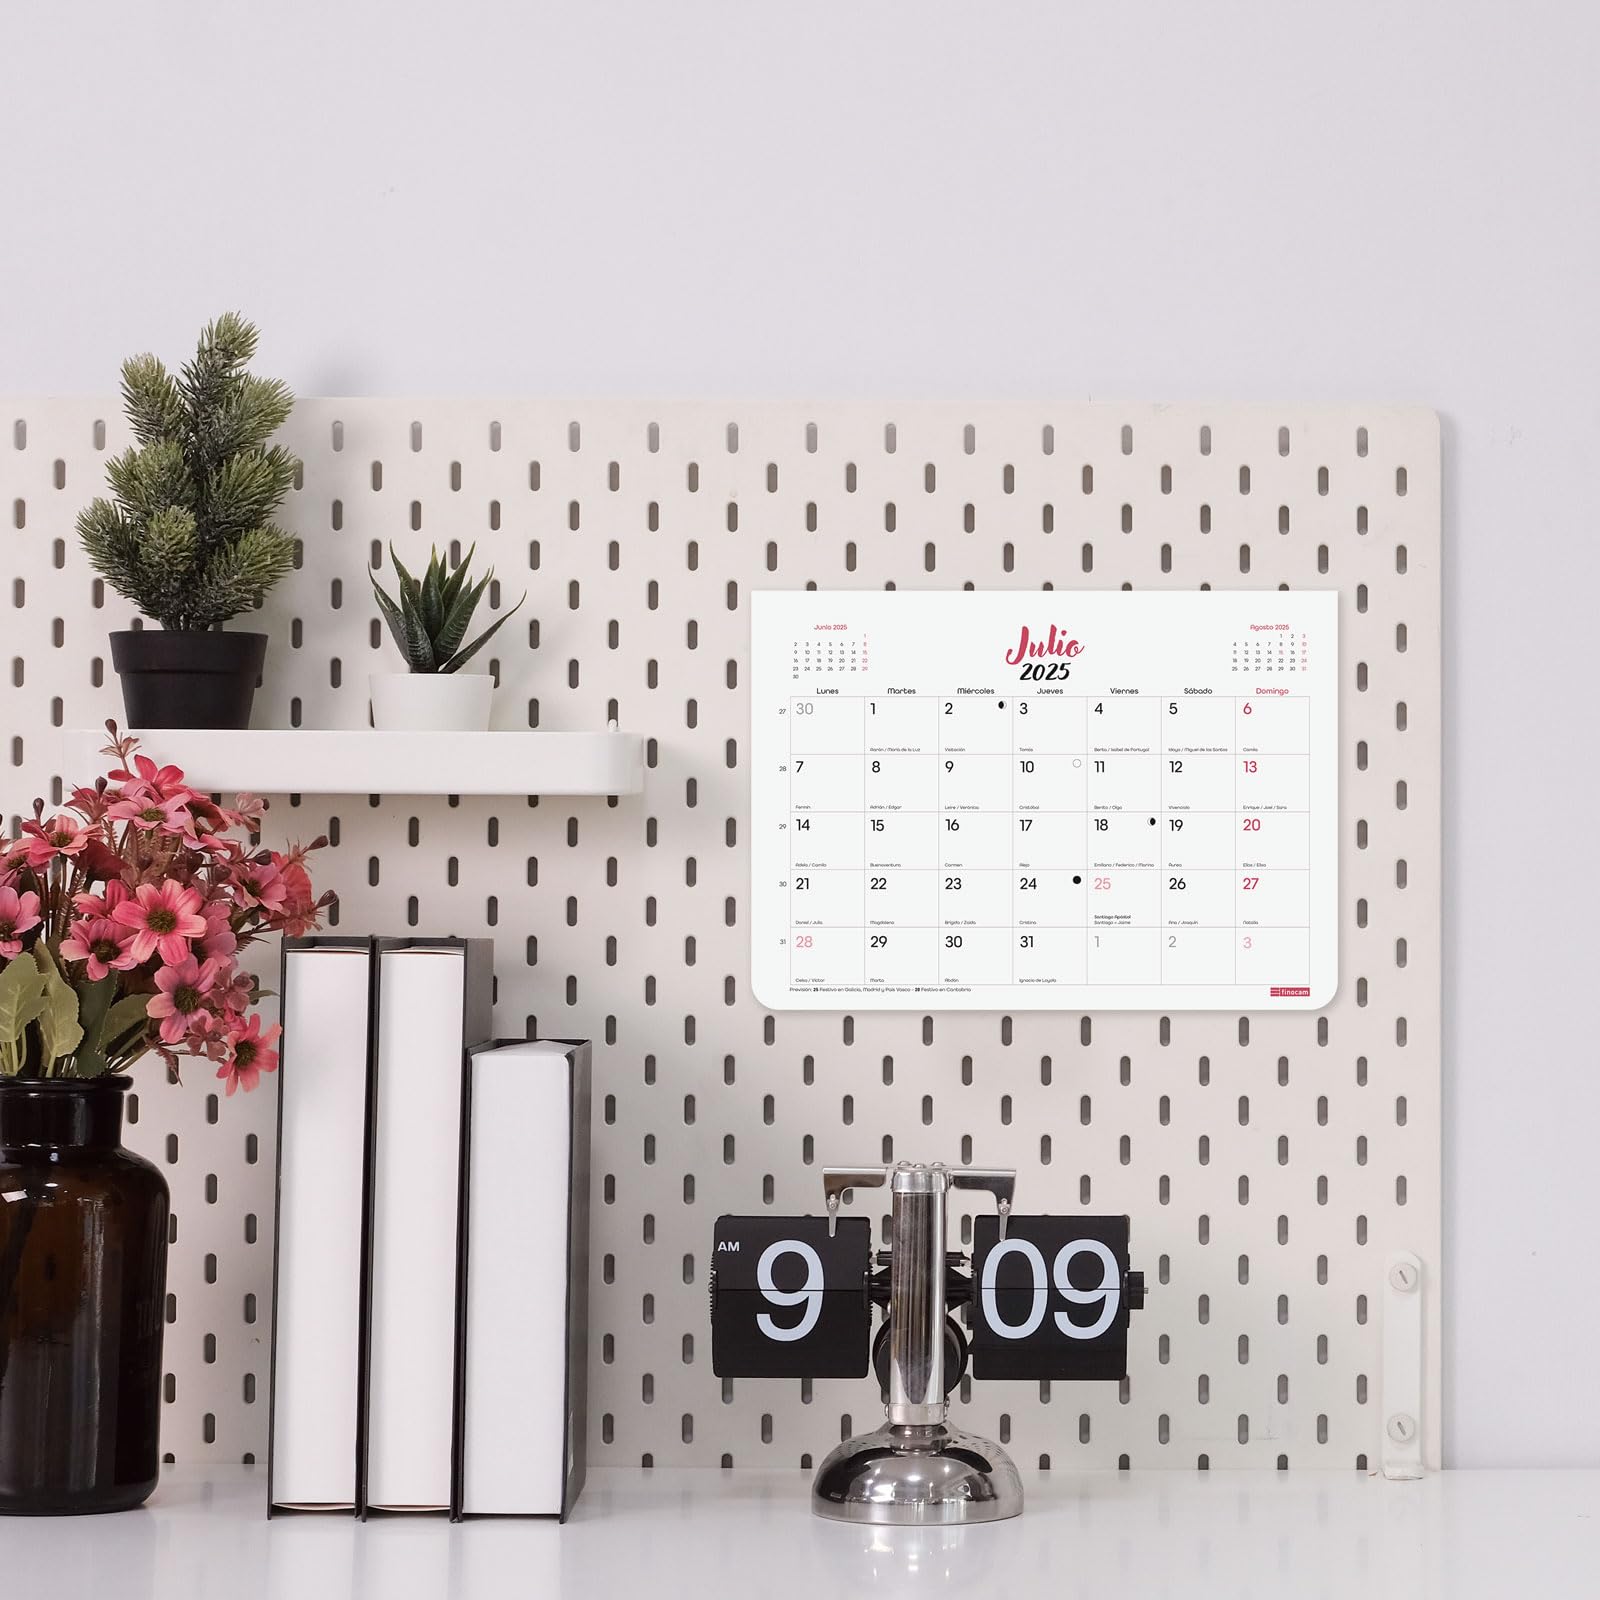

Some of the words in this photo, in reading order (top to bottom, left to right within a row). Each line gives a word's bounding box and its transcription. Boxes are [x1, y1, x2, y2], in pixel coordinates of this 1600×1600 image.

[1250, 624, 1274, 632] Agosto
[1006, 624, 1085, 665] Julio
[1020, 663, 1071, 681] 2025
[957, 687, 996, 695] Miércoles
[1183, 687, 1213, 695] Sábado
[1255, 687, 1290, 698] Domingo
[796, 703, 813, 715] 30
[870, 703, 875, 715] 1
[945, 703, 953, 714] 2
[1020, 702, 1028, 715] 3
[1094, 703, 1103, 714] 4
[1169, 703, 1178, 715] 5
[1243, 702, 1252, 715] 6
[796, 761, 804, 773] 7
[872, 761, 880, 773] 8
[945, 761, 954, 773] 9
[1020, 761, 1034, 773] 10
[1094, 761, 1104, 773] 11
[1169, 761, 1182, 773] 12
[1243, 761, 1257, 773] 13
[796, 819, 810, 831] 14
[870, 819, 884, 831] 15
[945, 819, 959, 831] 16
[1019, 819, 1032, 831] 17
[1094, 819, 1108, 831] 18
[1169, 819, 1183, 831] 19
[1243, 819, 1260, 831] 20
[796, 878, 809, 890] 21
[871, 878, 887, 890] 22
[945, 878, 962, 890] 23
[1020, 877, 1037, 890] 24
[1095, 878, 1111, 889] 25
[1169, 878, 1186, 890] 26
[1243, 877, 1259, 890] 27
[796, 936, 812, 947] 28
[871, 936, 887, 948] 29
[945, 936, 962, 948] 30
[1020, 936, 1033, 948] 31
[1095, 936, 1099, 947] 1
[1169, 936, 1176, 947] 2
[1244, 937, 1251, 948] 3
[718, 1241, 740, 1252] AM
[757, 1240, 824, 1341] 9
[981, 1238, 1120, 1340] 09
